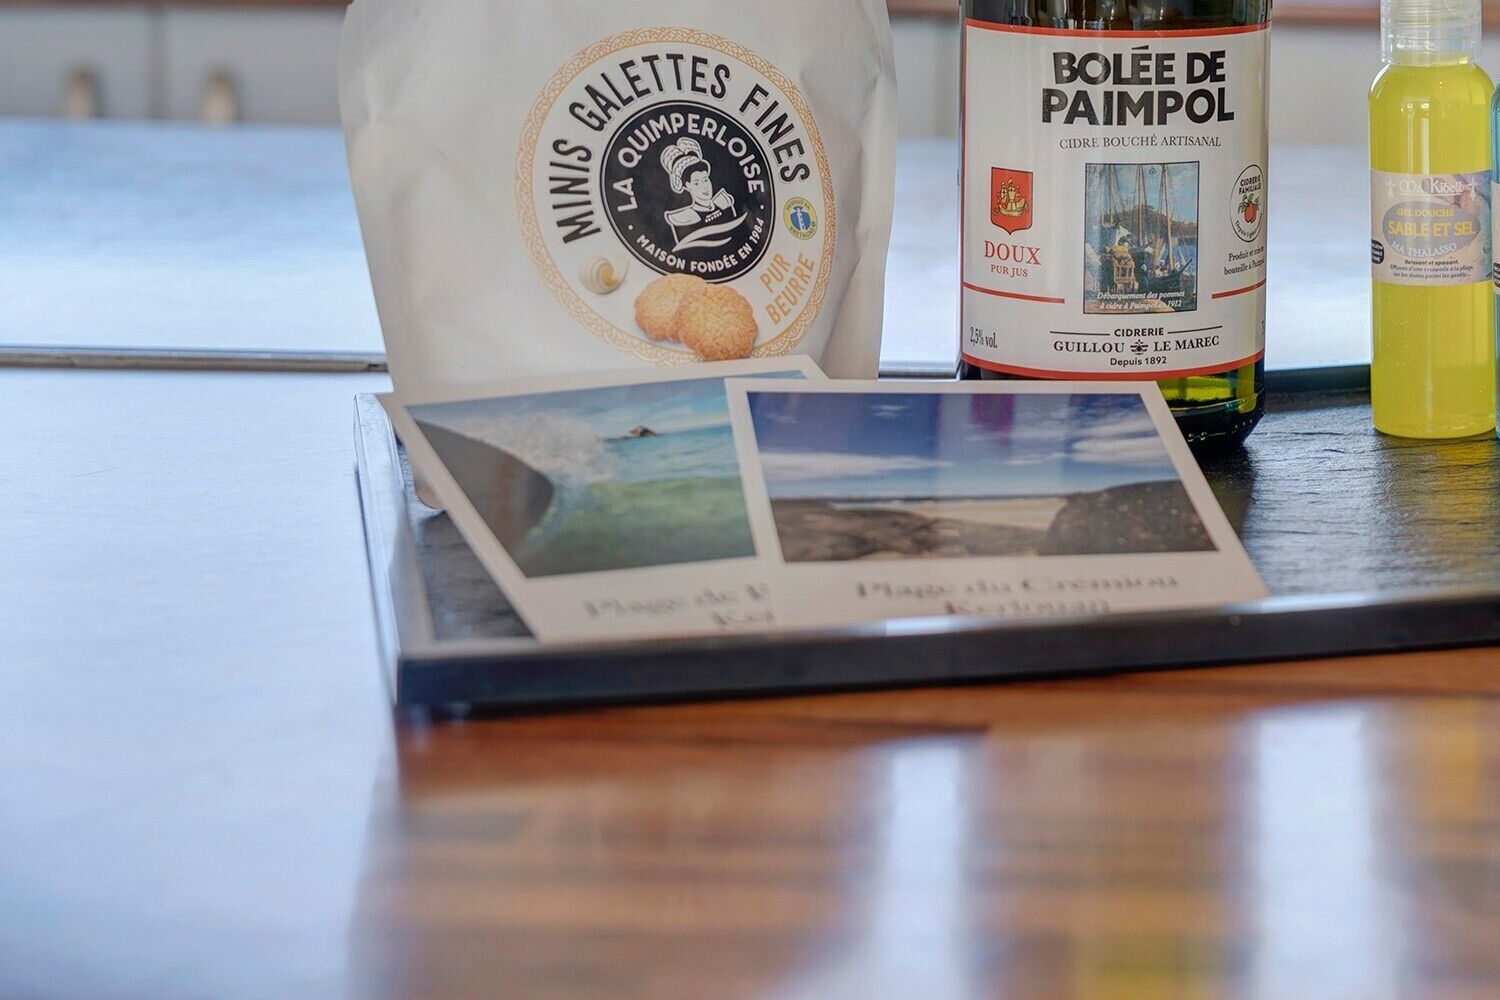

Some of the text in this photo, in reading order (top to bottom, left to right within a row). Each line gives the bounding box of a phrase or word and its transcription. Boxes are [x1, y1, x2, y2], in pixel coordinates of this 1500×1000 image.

[1053, 45, 1226, 85] BOLÉE DE
[1042, 87, 1235, 126] PAIMPOL
[549, 53, 811, 243] MINIS GALETTES FINES
[1060, 134, 1221, 149] CIDRE BOUCHÉ ARTISANAL
[613, 113, 765, 212] LA QUIMPERLOISE
[1397, 208, 1455, 217] GEL DOUCHE
[1388, 220, 1475, 237] SABLE ET SEL
[636, 217, 764, 273] MAISON FONDÉE EN 1984
[984, 240, 1041, 265] DOUX
[1391, 241, 1406, 254] MA
[1407, 242, 1457, 257] THALASSO
[1228, 249, 1248, 261] Produit
[760, 253, 791, 293] PUR
[991, 265, 1028, 278] PUR JUS
[1224, 263, 1248, 275] bouteille
[765, 253, 815, 325] BEURRE
[1146, 291, 1158, 299] des
[1159, 290, 1185, 300] pommes
[985, 332, 998, 349] vol.
[1114, 327, 1164, 337] CIDRERIE
[1053, 335, 1220, 353] GUILLOU LE MAREC
[1110, 356, 1167, 367] Depuis 1892
